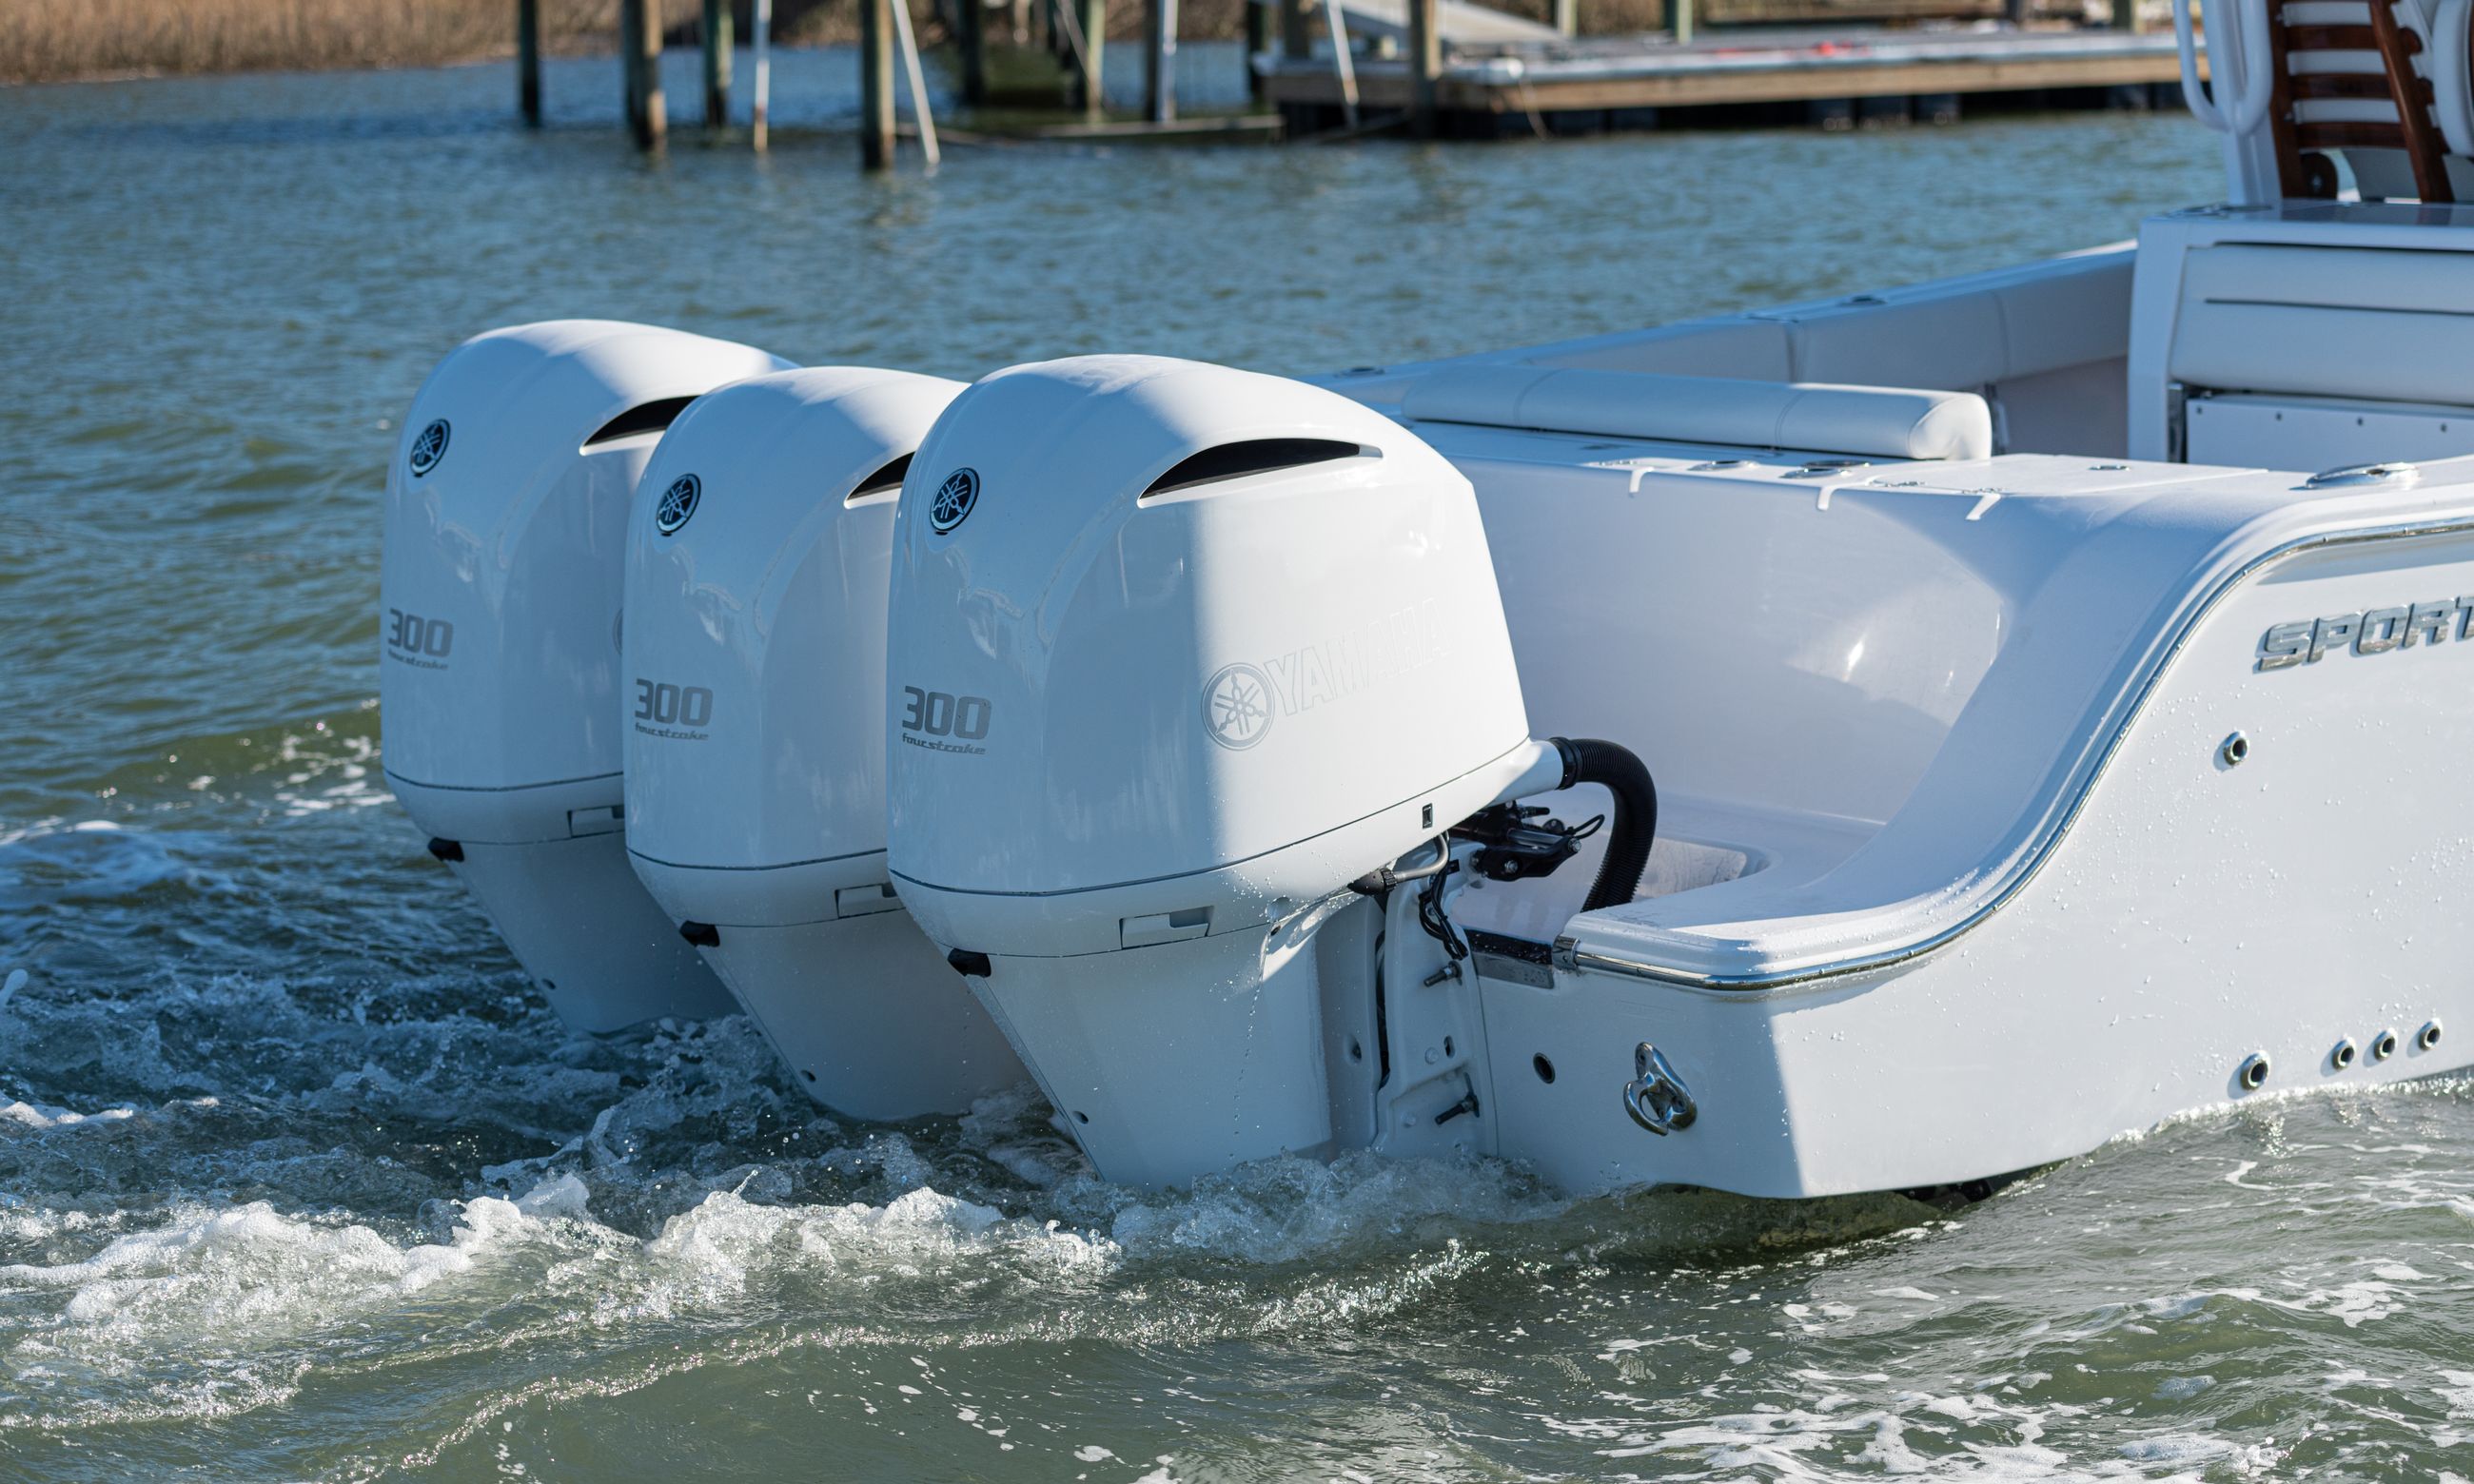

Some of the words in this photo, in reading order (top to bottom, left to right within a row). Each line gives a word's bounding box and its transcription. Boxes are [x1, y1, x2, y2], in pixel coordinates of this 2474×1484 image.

[388, 608, 454, 657] 300
[1264, 597, 1454, 716] YAMAHA
[635, 678, 713, 727] 300
[902, 686, 992, 739] 300
